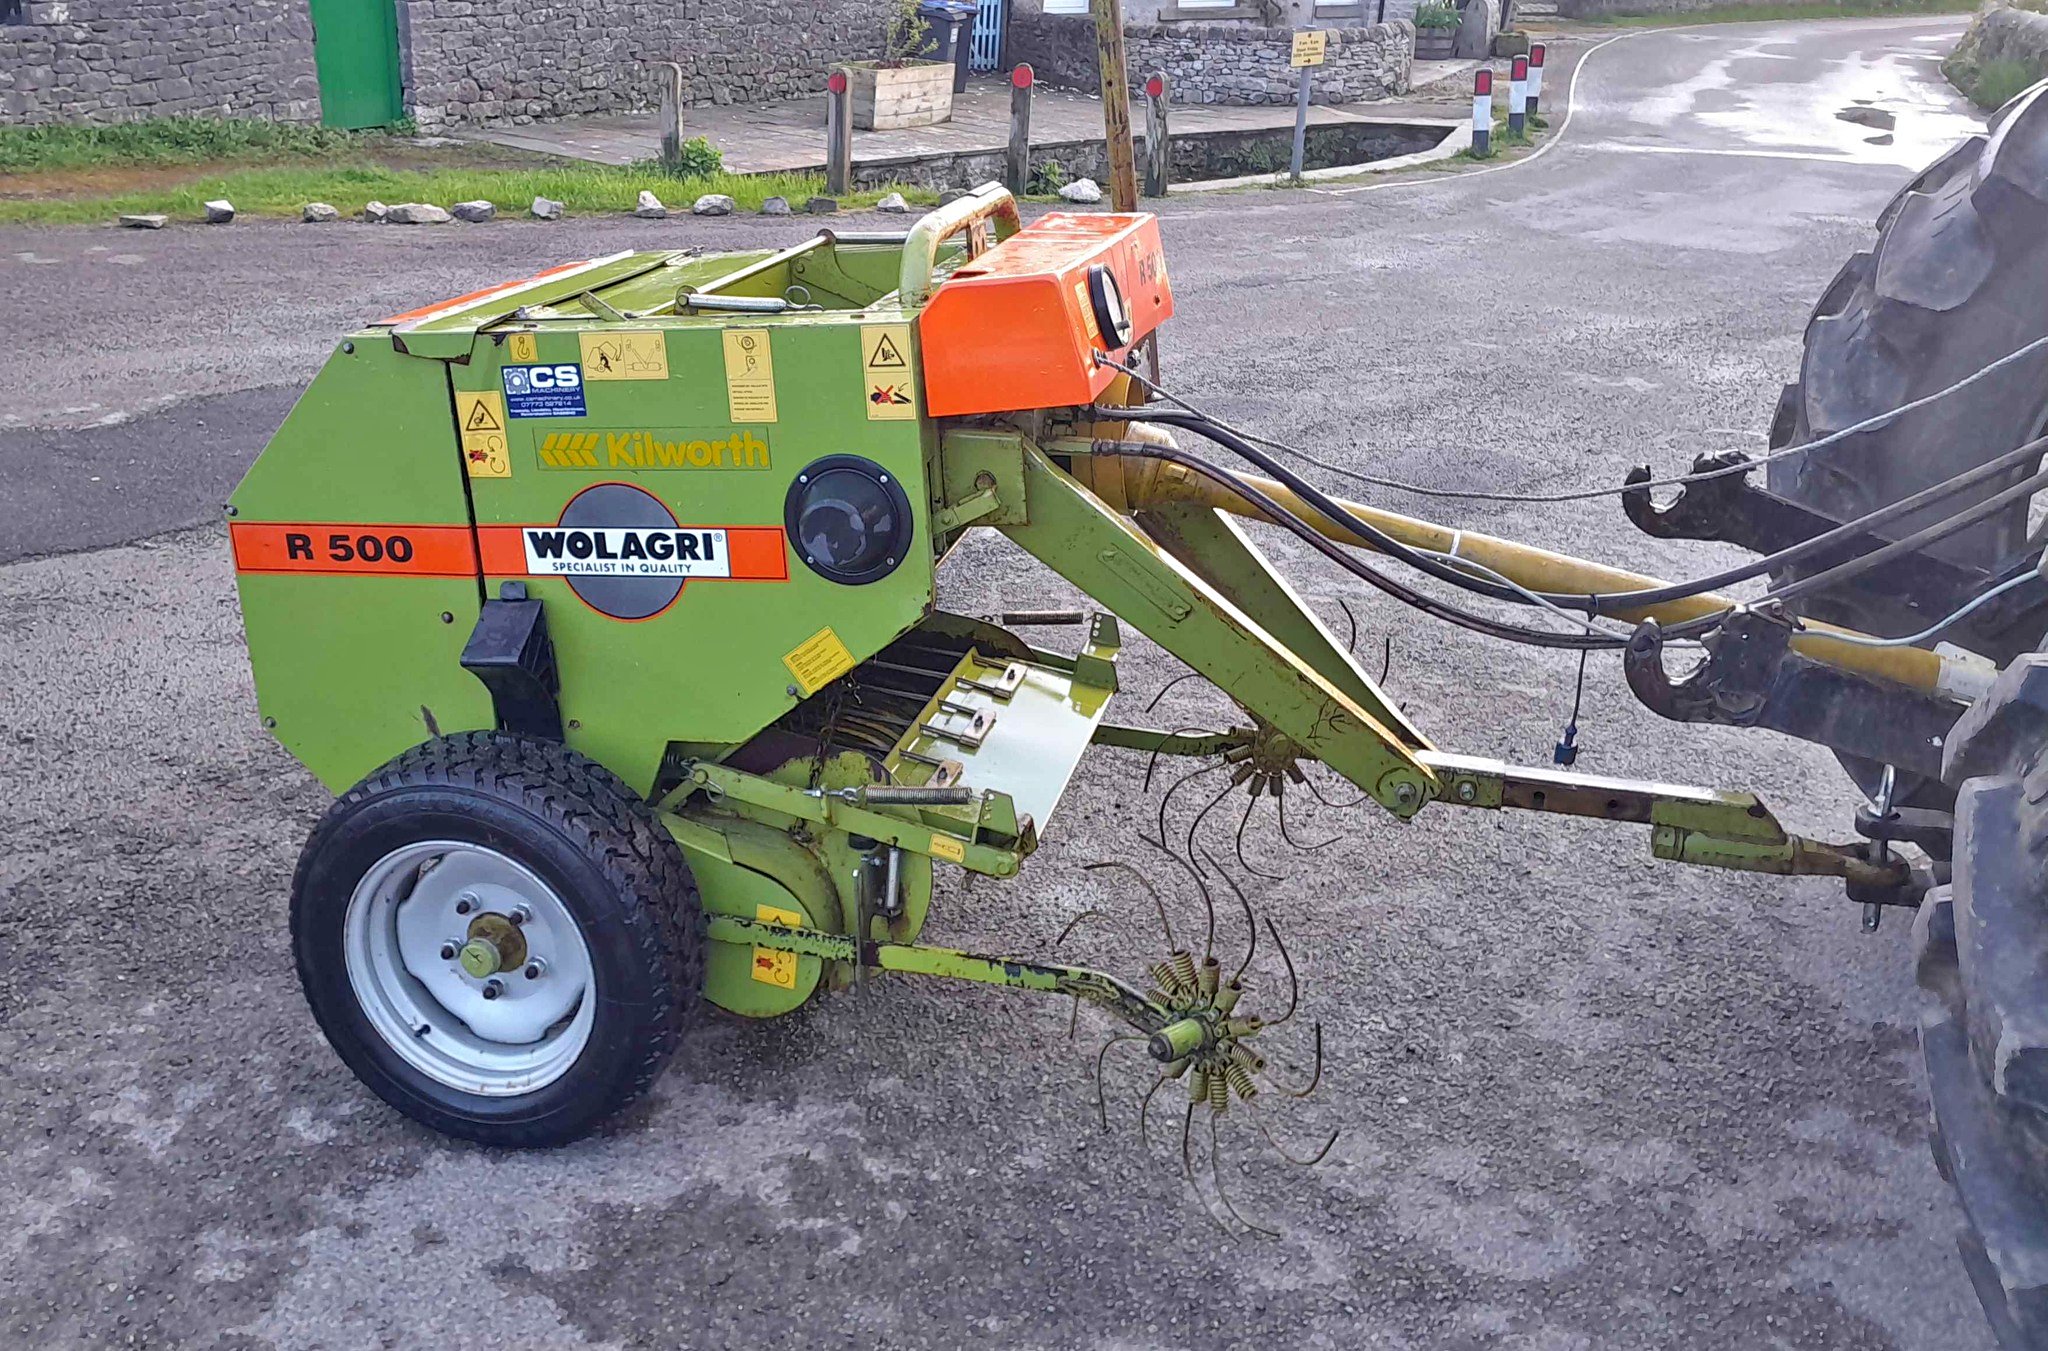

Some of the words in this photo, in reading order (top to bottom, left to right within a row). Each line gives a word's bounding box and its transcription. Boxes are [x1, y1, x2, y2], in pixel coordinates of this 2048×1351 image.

[1138, 258, 1147, 287] R
[529, 366, 579, 388] CS
[606, 430, 769, 468] Kilworth
[285, 533, 314, 560] R
[328, 534, 413, 563] 500
[527, 531, 715, 561] WOLAGRI
[552, 562, 616, 573] SPECIALIST
[621, 562, 635, 573] IN
[639, 563, 693, 574] QUALITY
